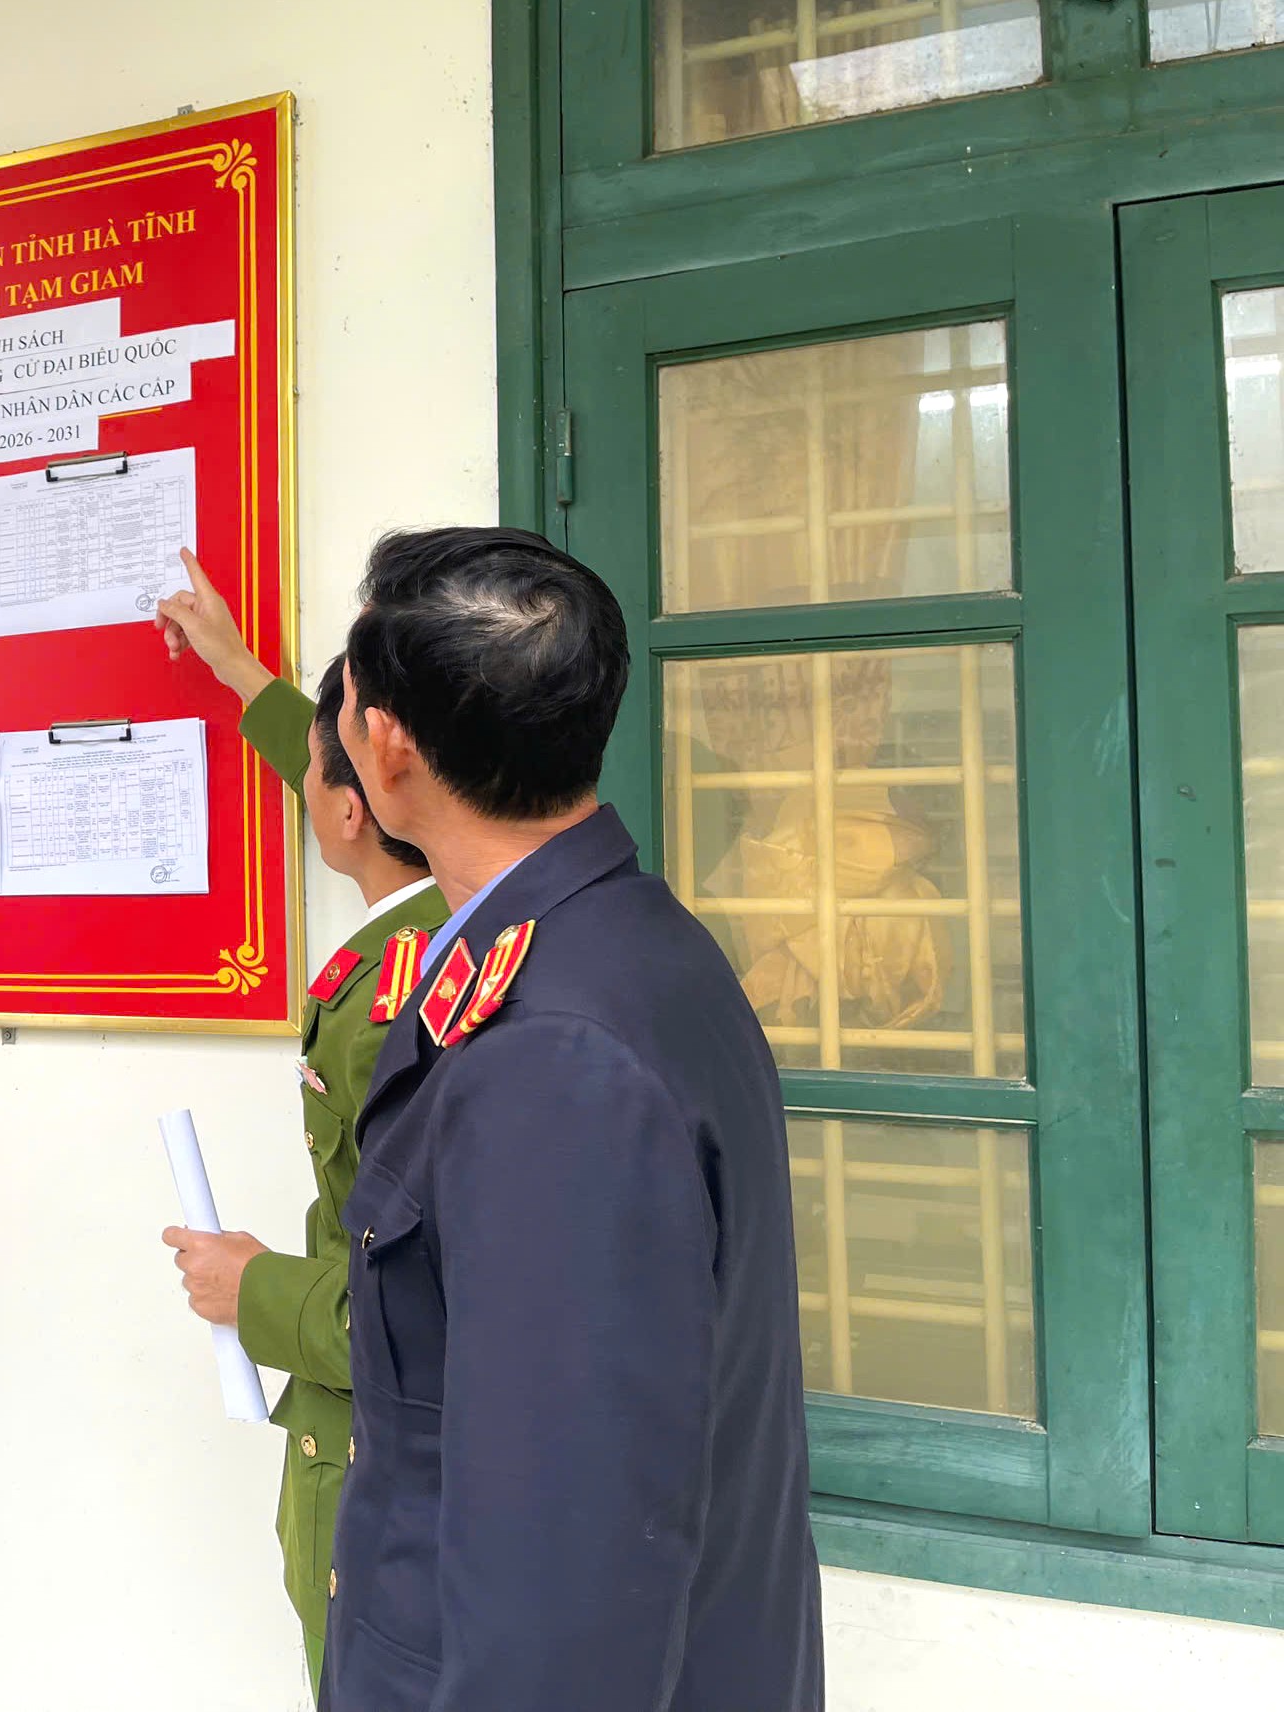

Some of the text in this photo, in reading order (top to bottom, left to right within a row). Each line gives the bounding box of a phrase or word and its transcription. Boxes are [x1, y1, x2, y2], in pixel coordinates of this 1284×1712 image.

[11, 233, 75, 265] TỈNH
[83, 218, 121, 252] HÀ
[127, 209, 196, 243] TĨNH
[4, 277, 63, 309] TẠM
[70, 262, 144, 295] GIAM
[18, 329, 64, 350] SÁCH
[14, 358, 41, 379] CỬ
[43, 353, 74, 375] ĐẠI
[1, 395, 51, 419] NHÂN
[56, 389, 93, 411] DÂN
[98, 383, 135, 404] CÁC
[0, 431, 34, 450] 2026
[47, 424, 81, 443] 2031
